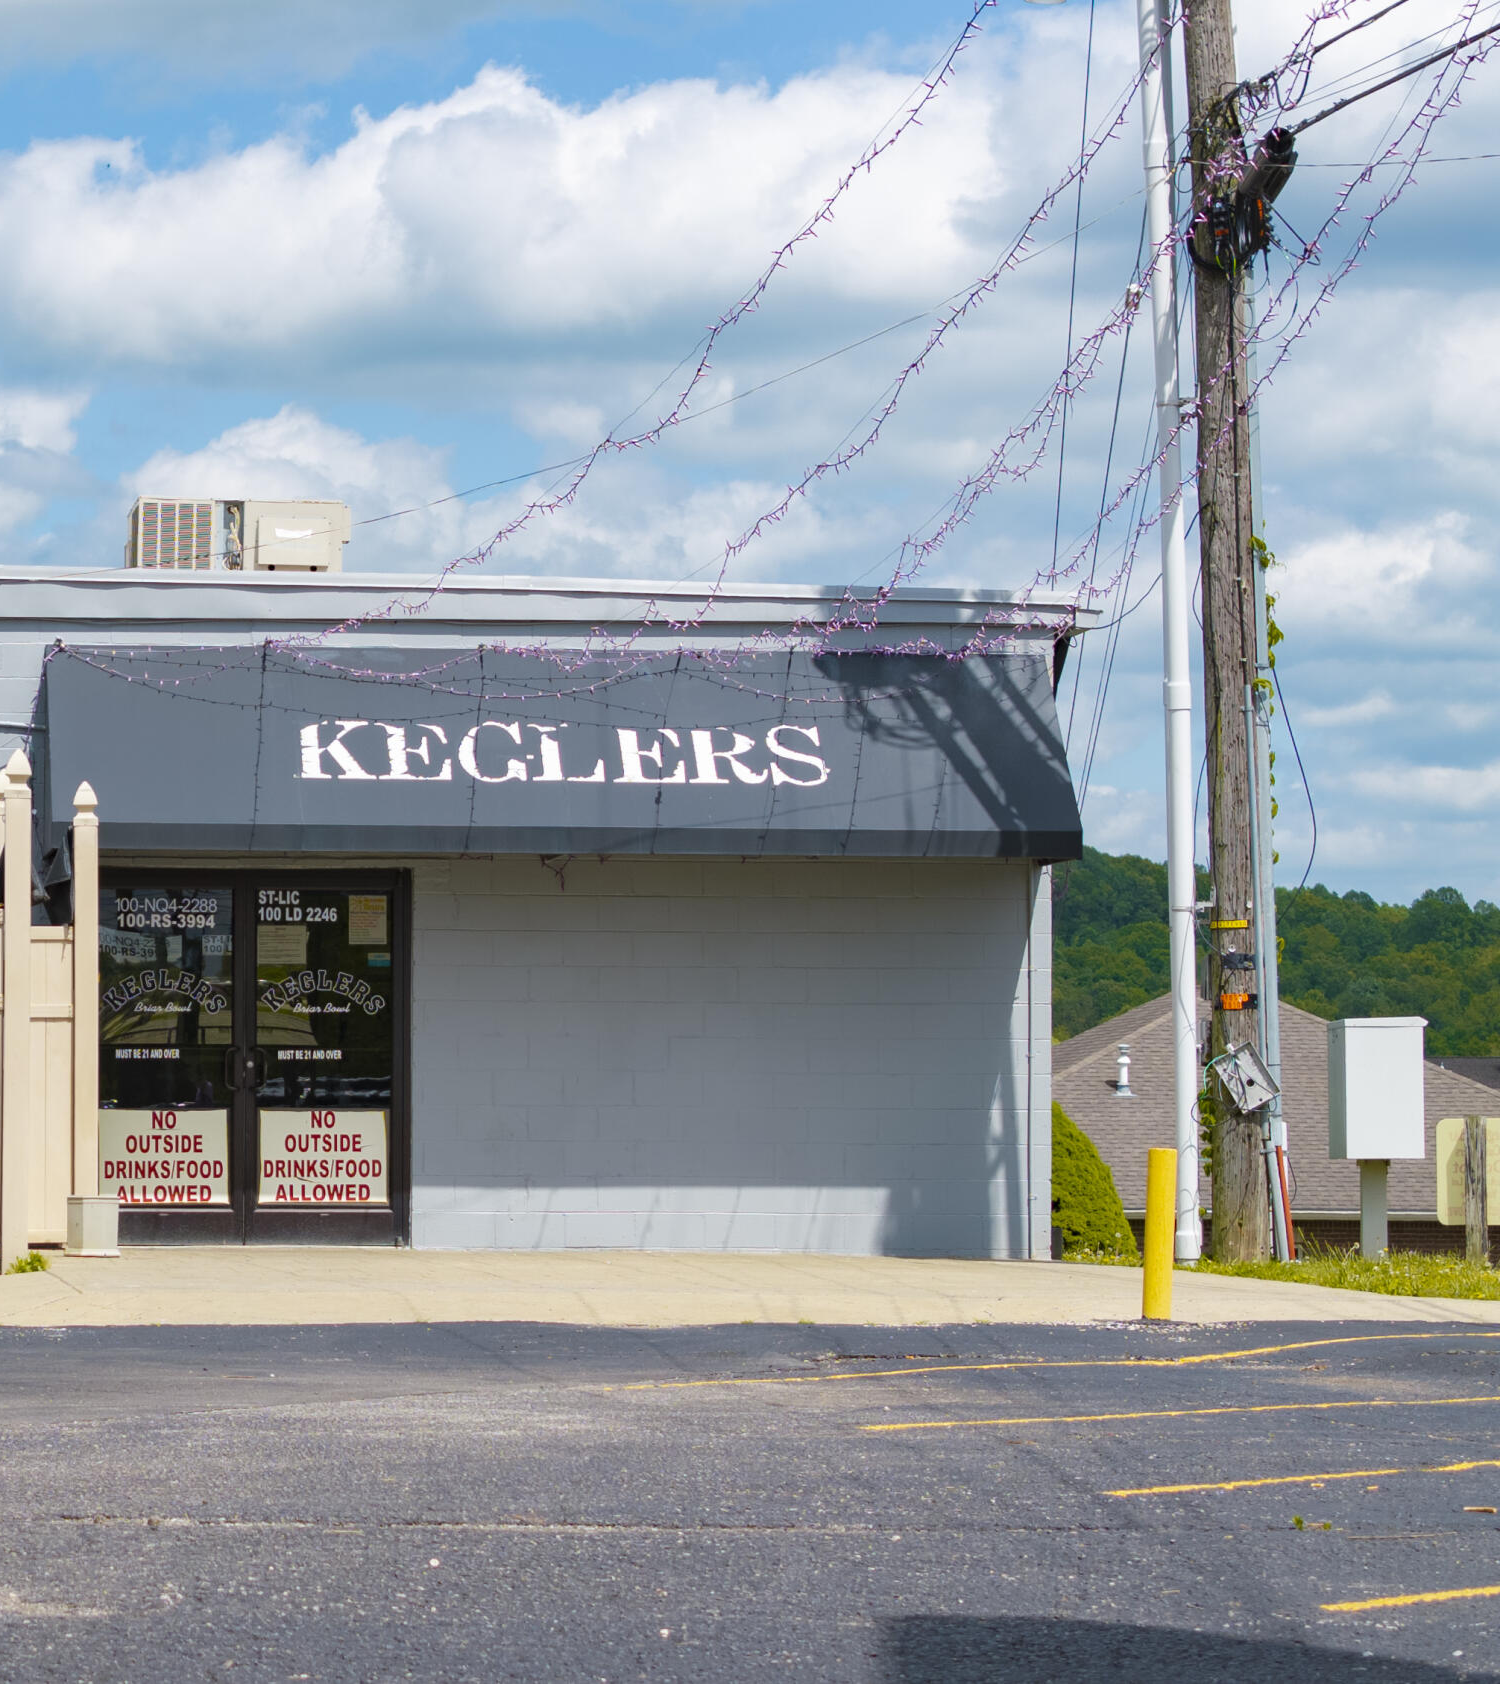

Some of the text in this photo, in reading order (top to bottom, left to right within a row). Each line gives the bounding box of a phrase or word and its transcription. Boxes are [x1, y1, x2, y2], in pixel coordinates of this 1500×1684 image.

[294, 720, 830, 787] KEGLERS
[116, 898, 218, 914] 100-NQ4-2288
[258, 890, 299, 905] ST-LIC
[117, 914, 216, 928] 100-RS-3994
[258, 907, 337, 922] 100 LD 2246
[103, 969, 227, 1015] KEGLERS
[261, 969, 385, 1015] KEGLERS
[116, 1049, 180, 1059] MUST BE 21 AND OVER
[277, 1050, 342, 1060] MUST BE 21 AND OVER
[152, 1111, 176, 1129] NO
[311, 1111, 335, 1128] NO
[126, 1135, 203, 1153] OUTSIDE
[285, 1134, 362, 1152] OUTSIDE
[104, 1160, 223, 1179] DRINKS/FOOD
[264, 1159, 382, 1178] DRINKS/FOOD
[117, 1185, 211, 1202] ALLOWED
[276, 1184, 370, 1201] ALLOWED
